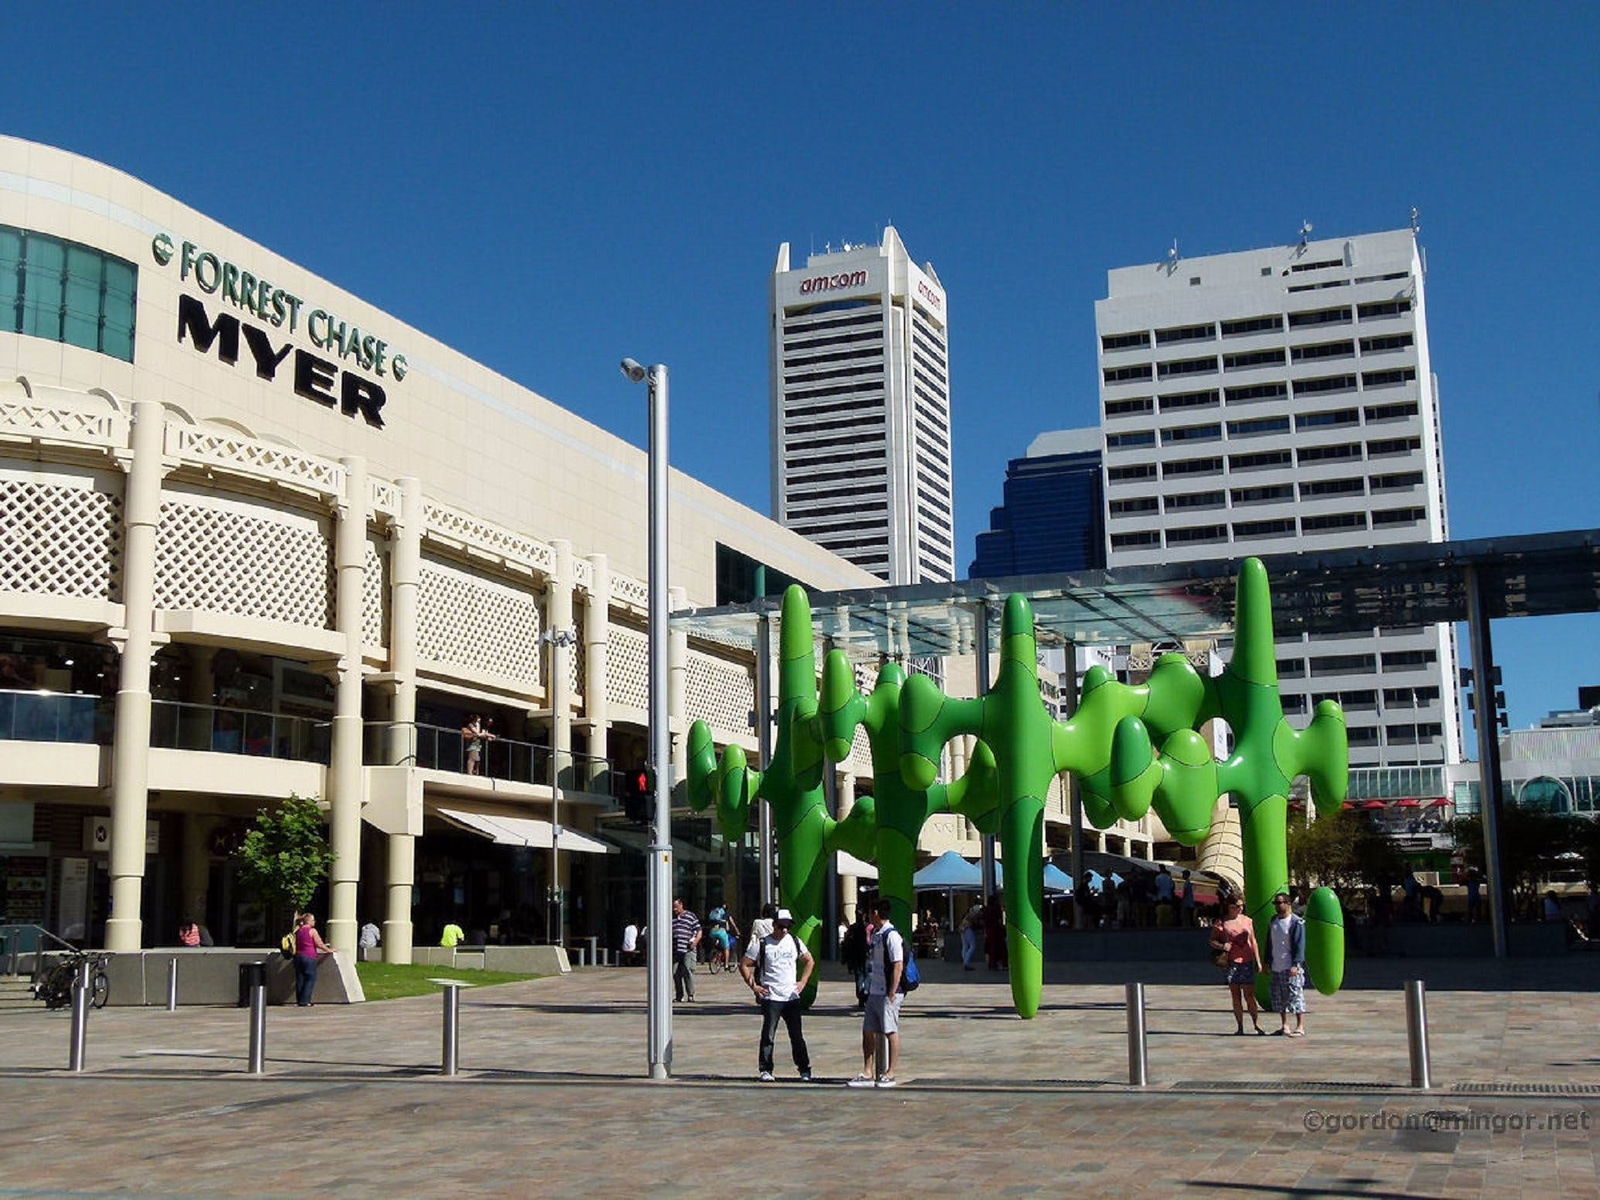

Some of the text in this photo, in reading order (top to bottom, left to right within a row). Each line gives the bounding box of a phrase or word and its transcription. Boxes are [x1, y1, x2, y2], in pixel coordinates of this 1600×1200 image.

[181, 240, 388, 377] FORREST CHASE
[801, 270, 867, 293] amcom
[178, 294, 387, 430] MYER
